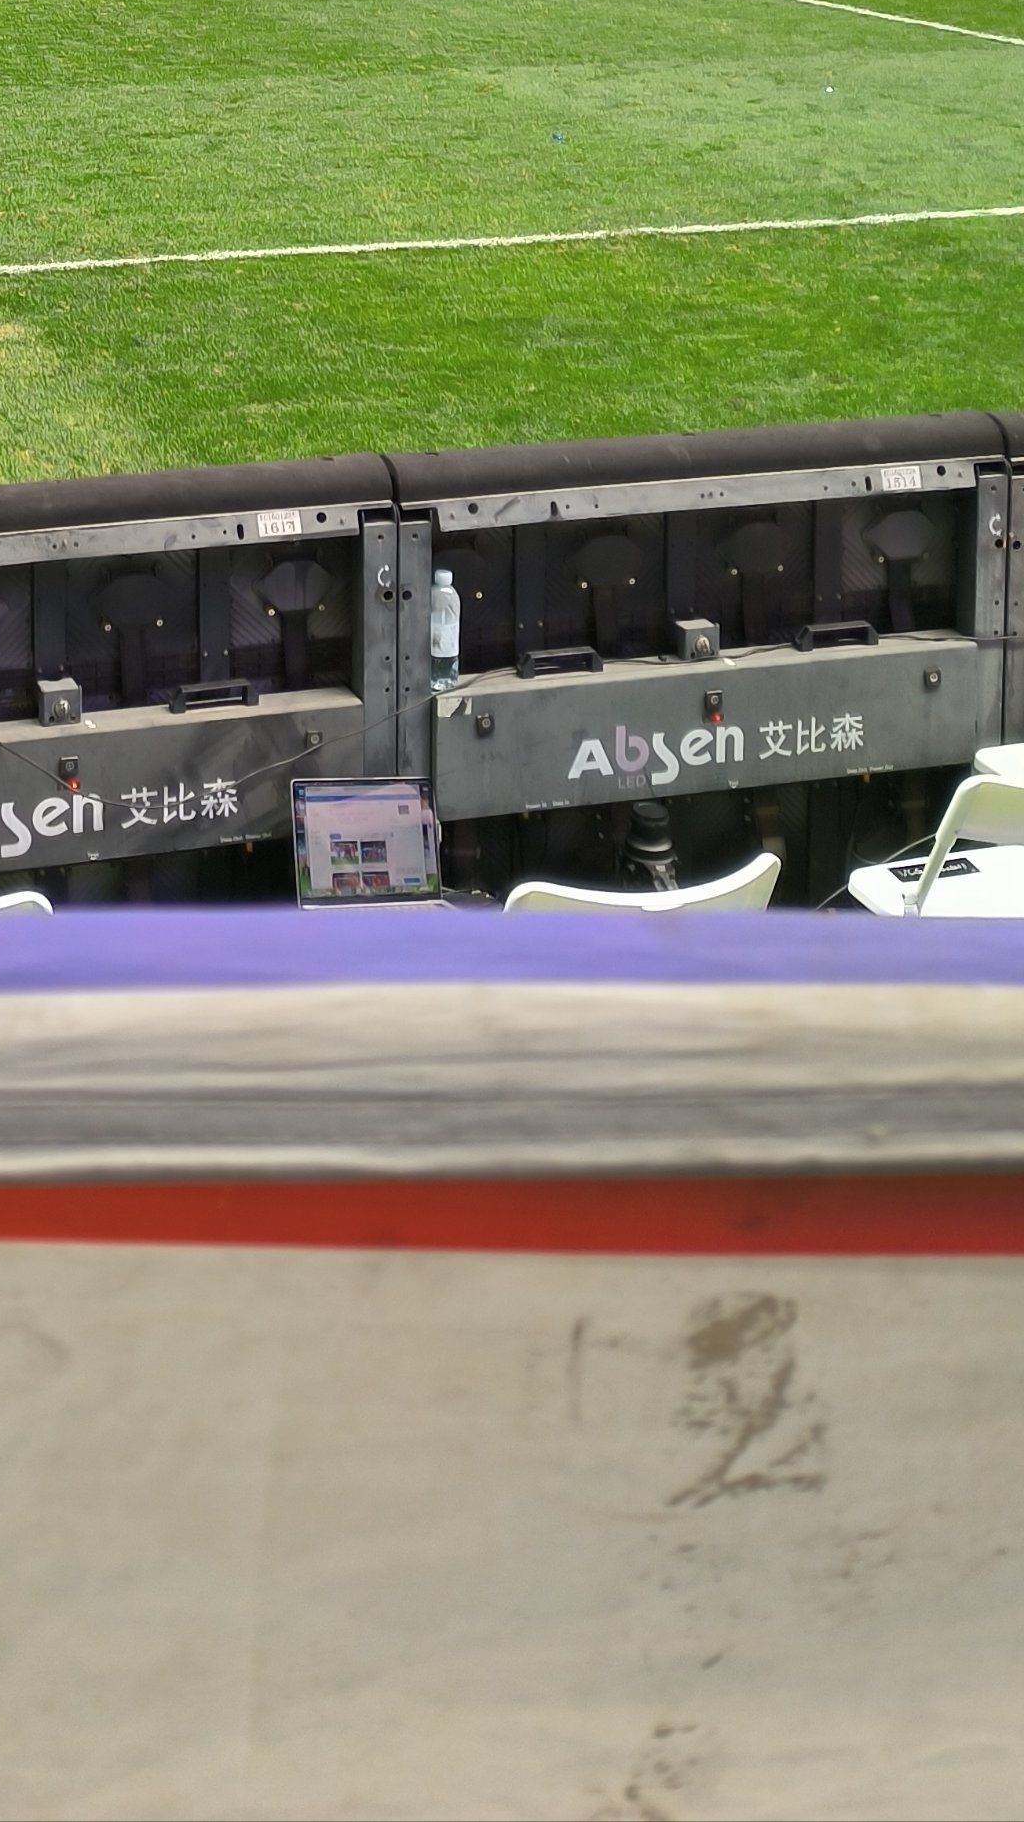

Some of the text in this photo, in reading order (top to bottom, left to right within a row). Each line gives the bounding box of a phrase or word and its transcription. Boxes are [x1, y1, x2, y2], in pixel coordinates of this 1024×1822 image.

[567, 713, 864, 786] Absen 艾比森
[120, 778, 239, 830] 艾比森
